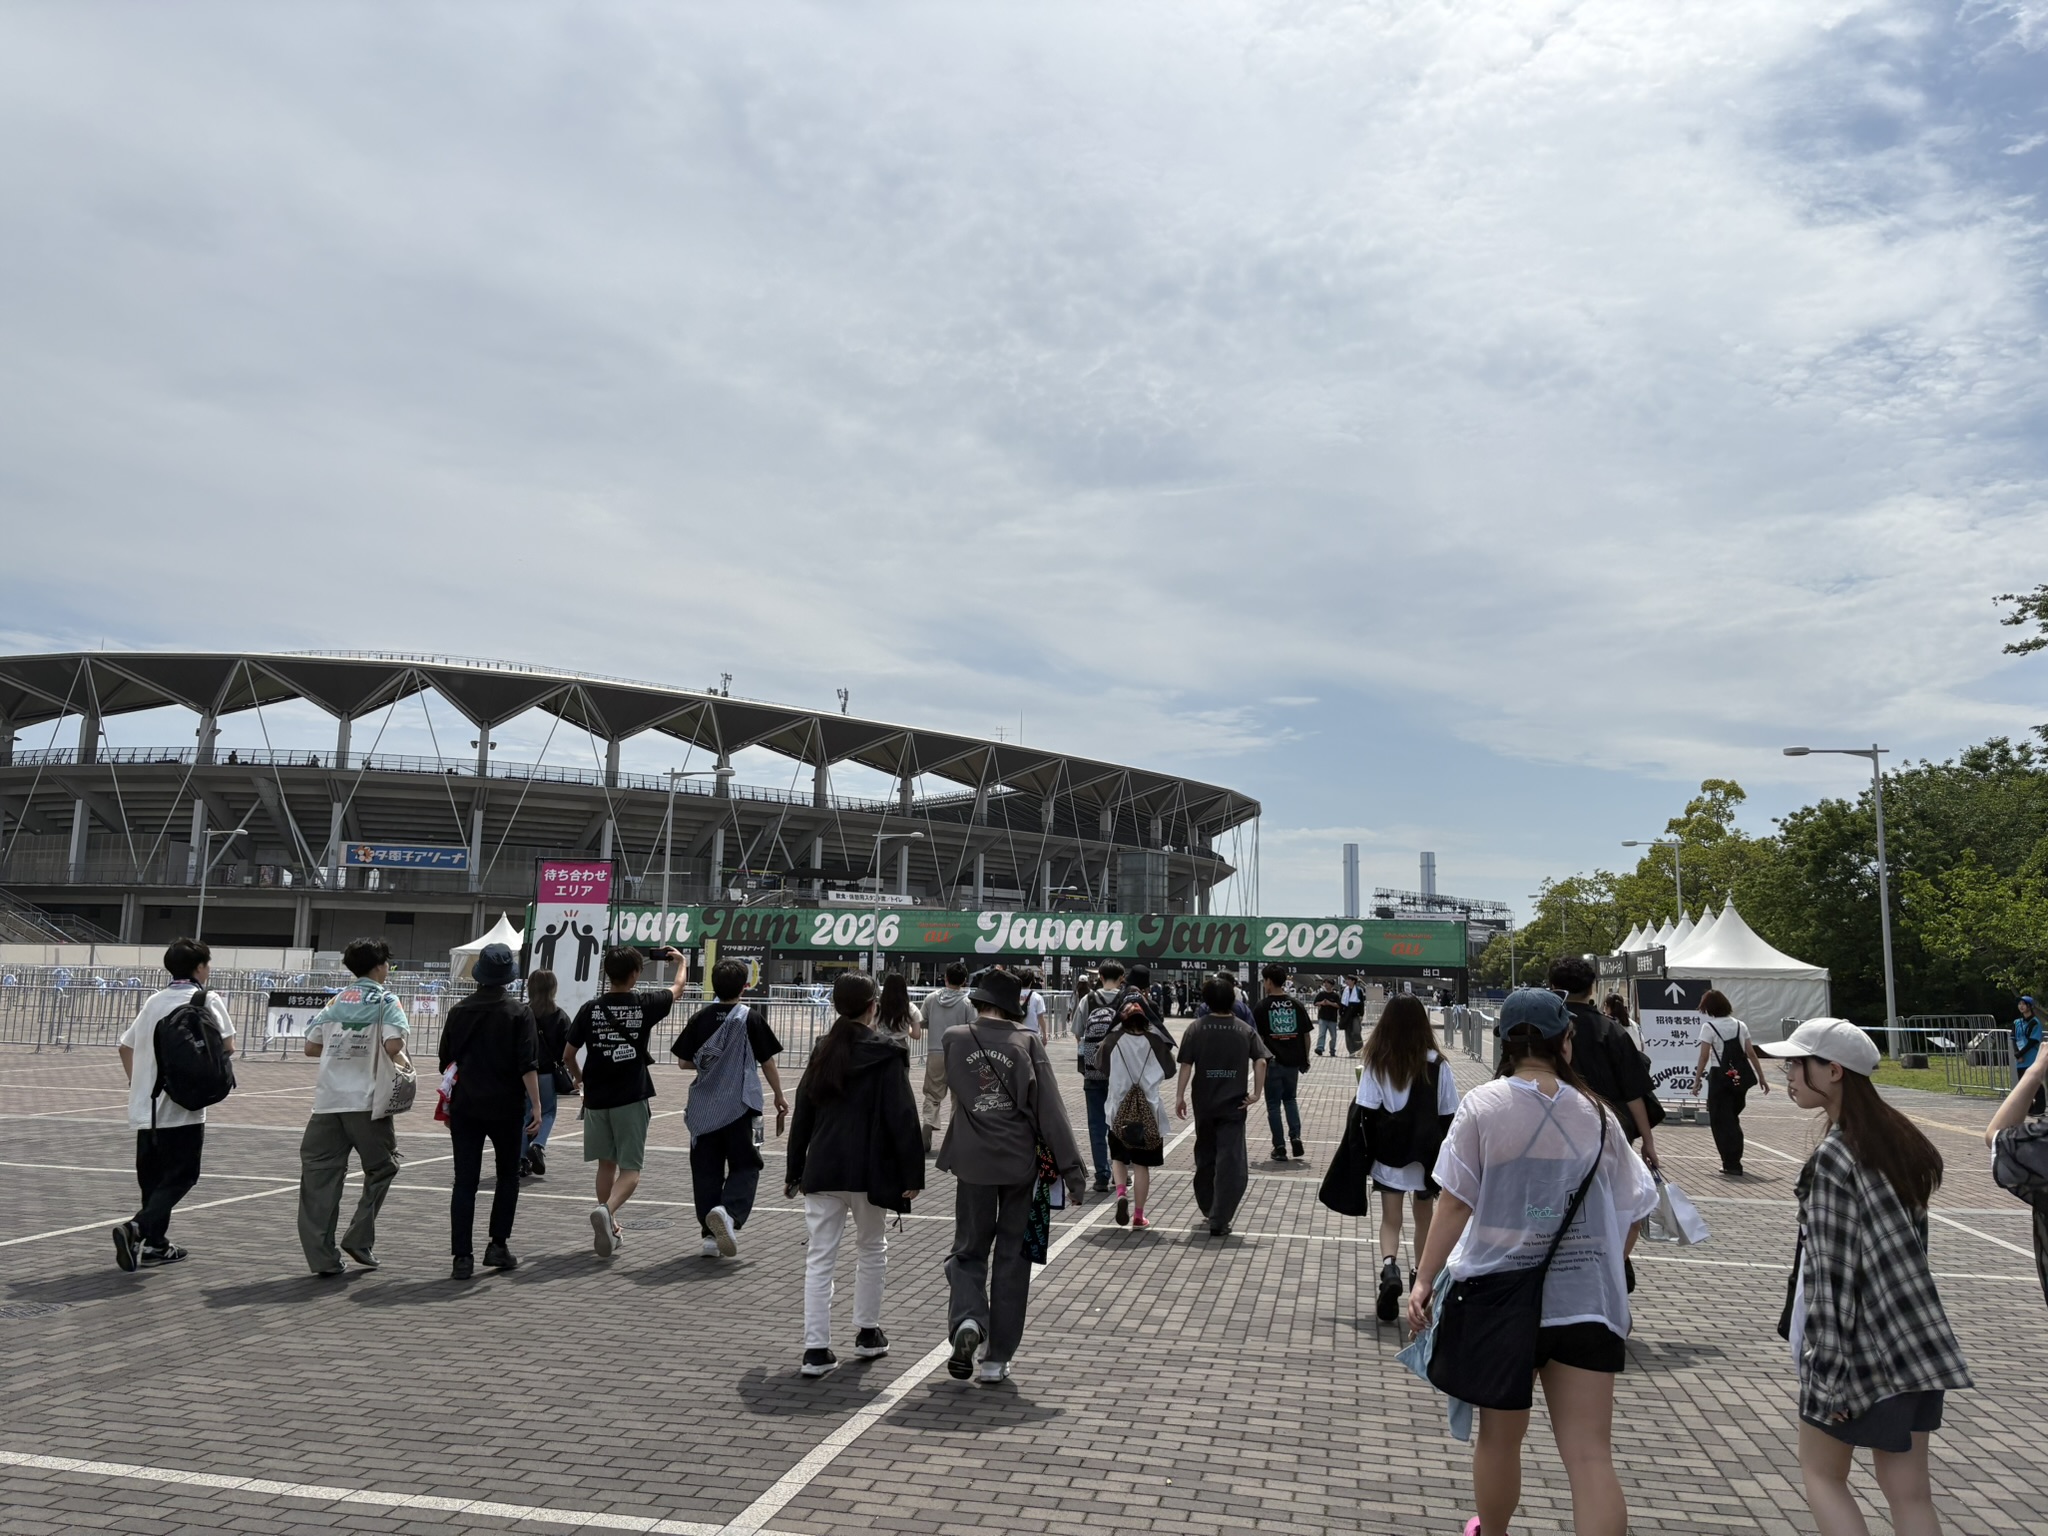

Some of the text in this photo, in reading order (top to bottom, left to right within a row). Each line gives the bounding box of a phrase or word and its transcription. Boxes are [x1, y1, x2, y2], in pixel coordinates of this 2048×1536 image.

[544, 869, 608, 881] 待ち合わせ
[554, 885, 593, 897] エリア
[607, 907, 900, 946] pan Jam 2026
[924, 930, 954, 943] au
[975, 911, 1364, 959] Japan Jam 2026
[1391, 942, 1425, 956] au
[1181, 961, 1208, 969] 再入場口
[1422, 968, 1440, 977] 出口
[1656, 1016, 1701, 1025] 招待者受付
[1671, 1030, 1689, 1039] 場外
[966, 1049, 1014, 1068] SWINGING
[1651, 1066, 1690, 1088] Japan
[972, 1099, 1013, 1112] Jazz Dance
